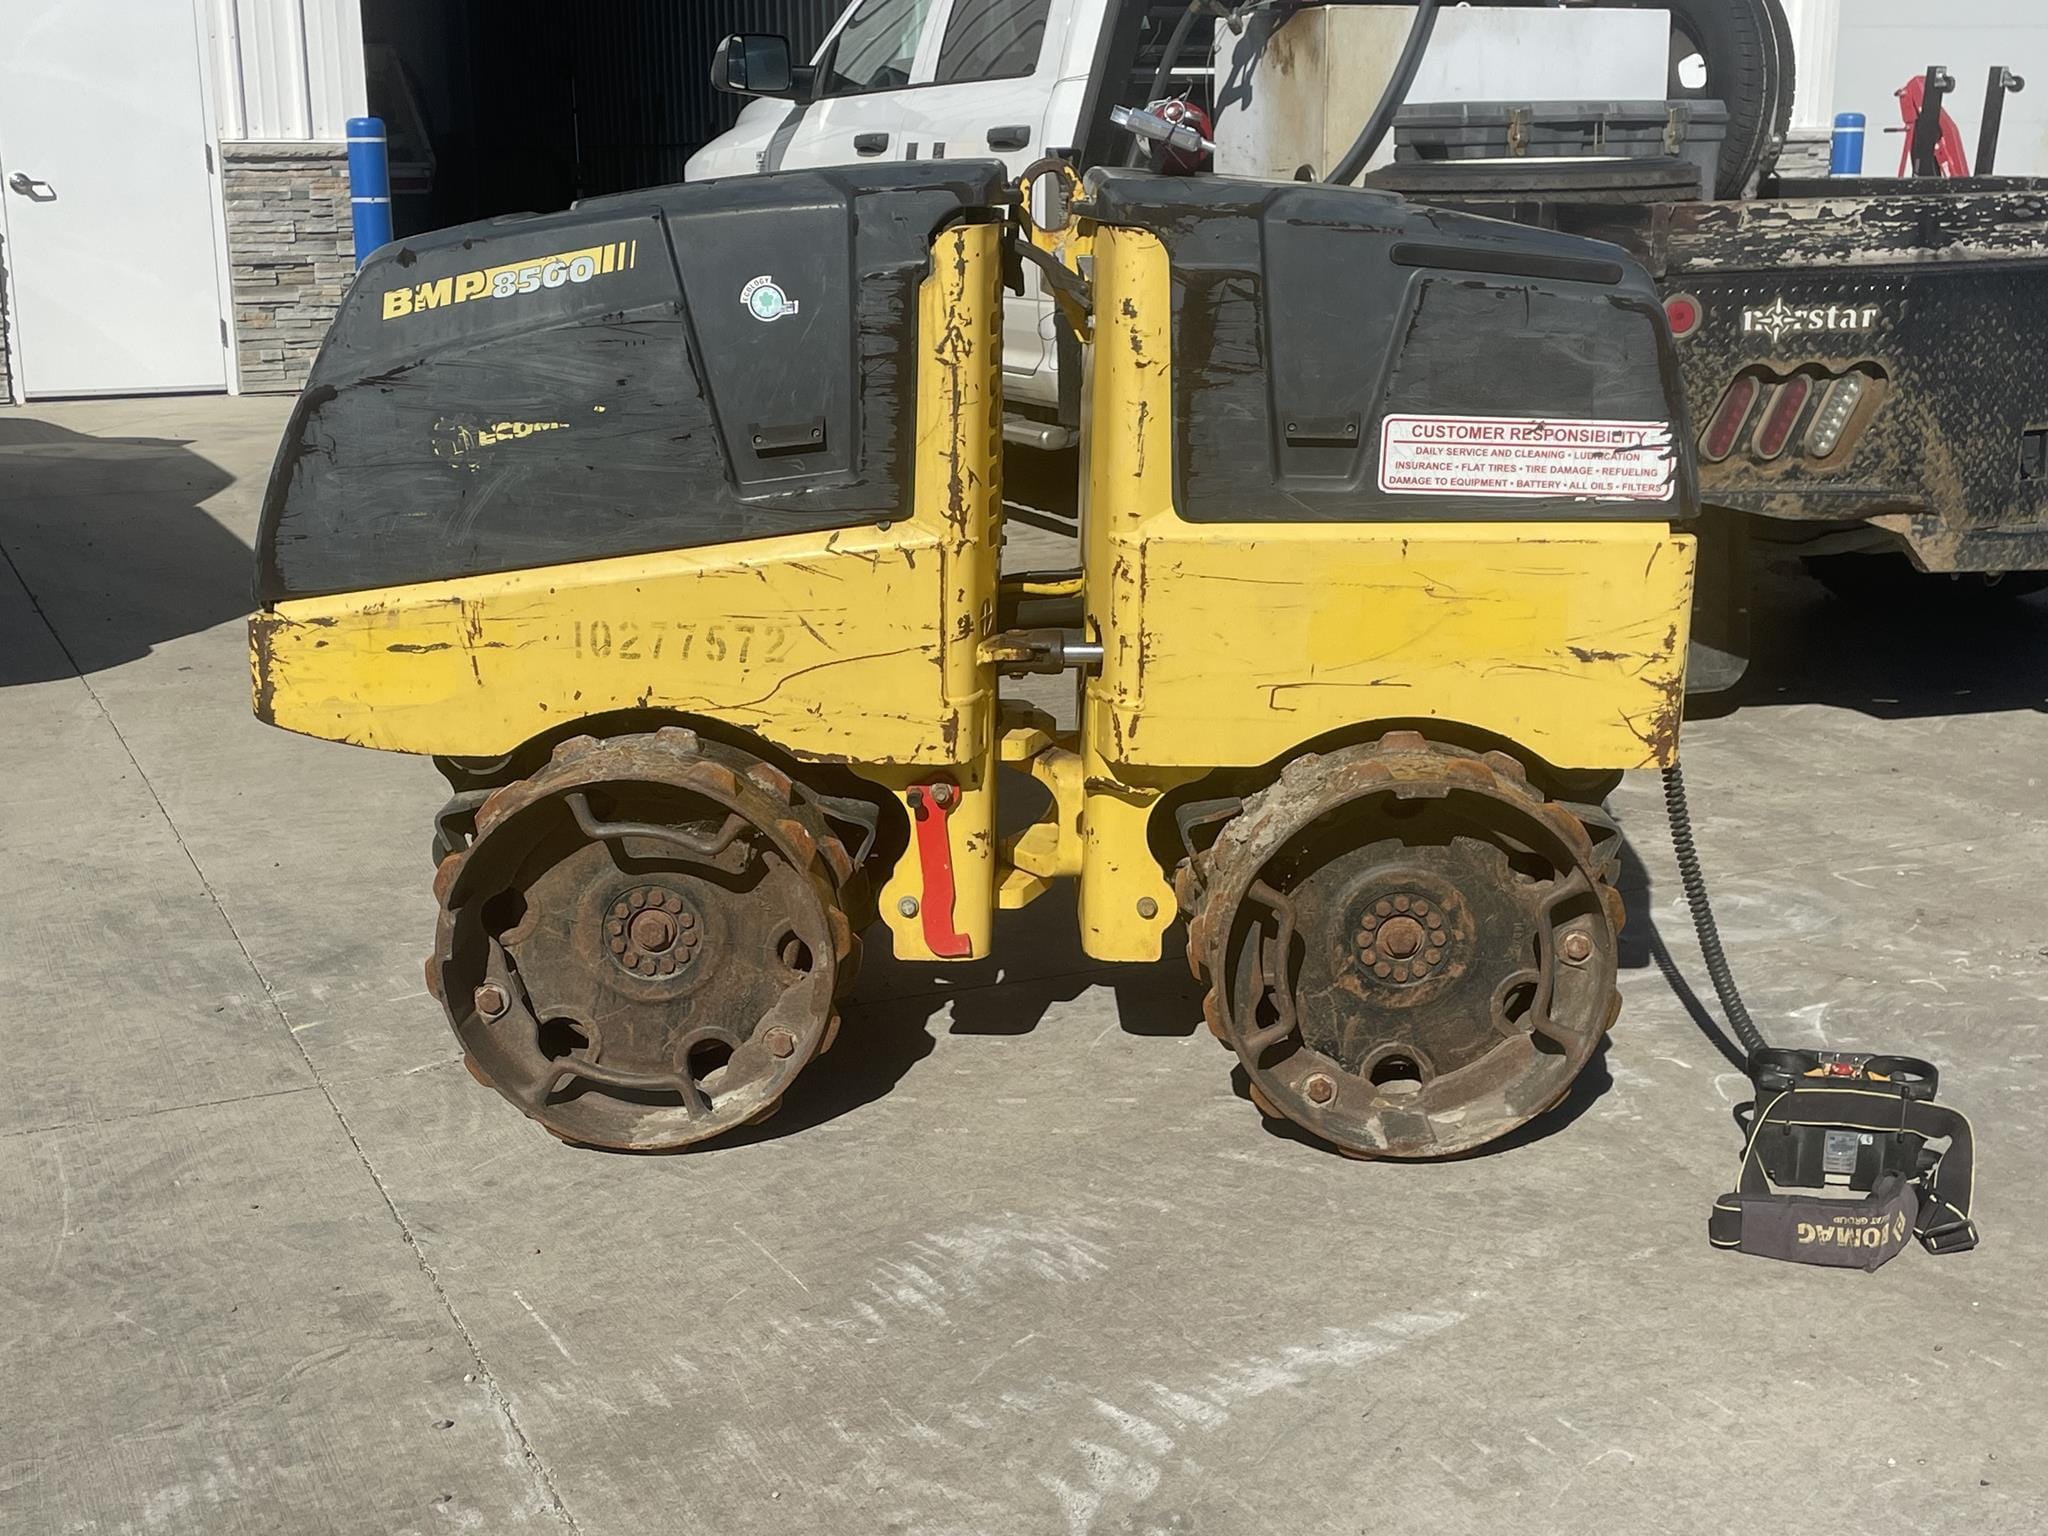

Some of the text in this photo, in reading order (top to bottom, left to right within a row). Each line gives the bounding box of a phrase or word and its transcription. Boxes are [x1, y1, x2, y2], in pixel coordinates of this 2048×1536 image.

[382, 270, 487, 321] BMP
[742, 277, 769, 302] ECOLOGY
[1411, 424, 1648, 445] CUSTOMER RESPONSIBILITY
[1415, 446, 1443, 456] DAILY
[1446, 447, 1488, 457] SERVICE
[1490, 449, 1512, 458] AND
[1514, 449, 1566, 460] CLEANING
[1395, 460, 1658, 478] INSURANCE FLAT TIRES TIRE DAMAGE REFUELING
[1389, 475, 1662, 492] DAMAGE TO EQUIPMENT BATTERY ALL OILS FILTERS
[574, 620, 785, 664] 10277572
